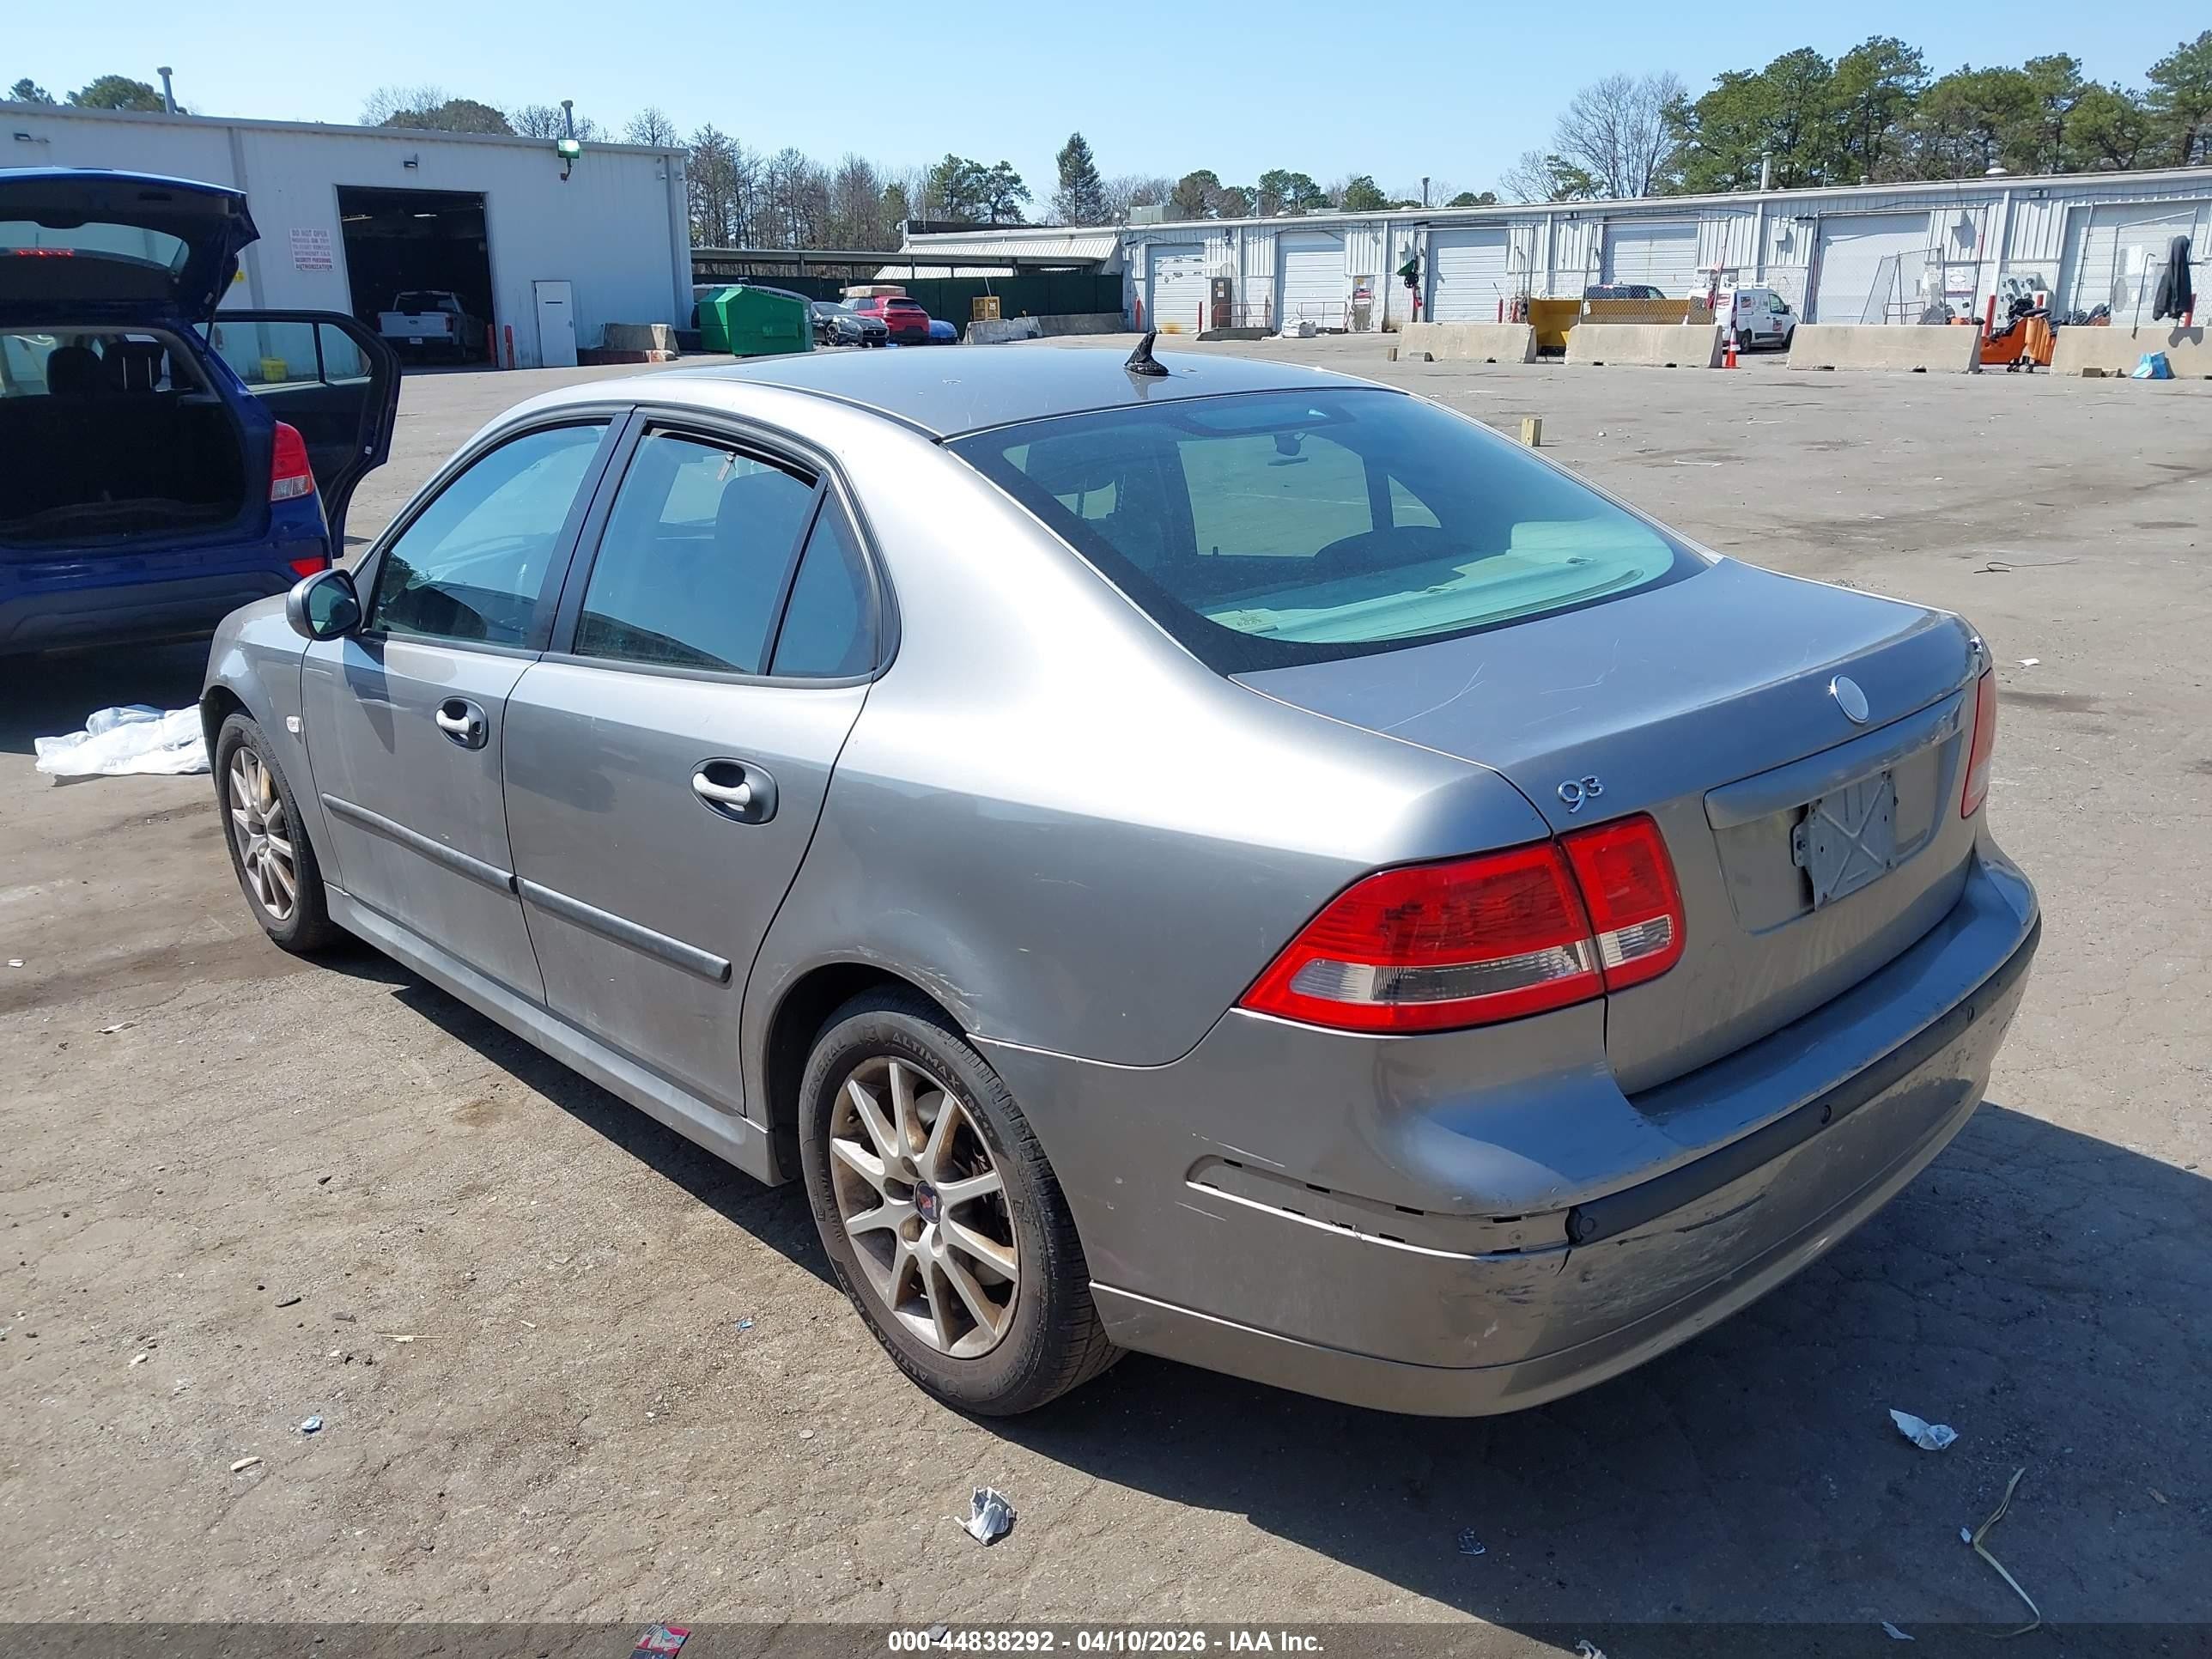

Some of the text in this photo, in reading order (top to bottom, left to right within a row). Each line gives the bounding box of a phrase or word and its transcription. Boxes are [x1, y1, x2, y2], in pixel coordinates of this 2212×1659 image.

[805, 1036, 848, 1114] GENERAL
[892, 1031, 961, 1088] ALTIMAX
[866, 1319, 929, 1382] ALTIMAX
